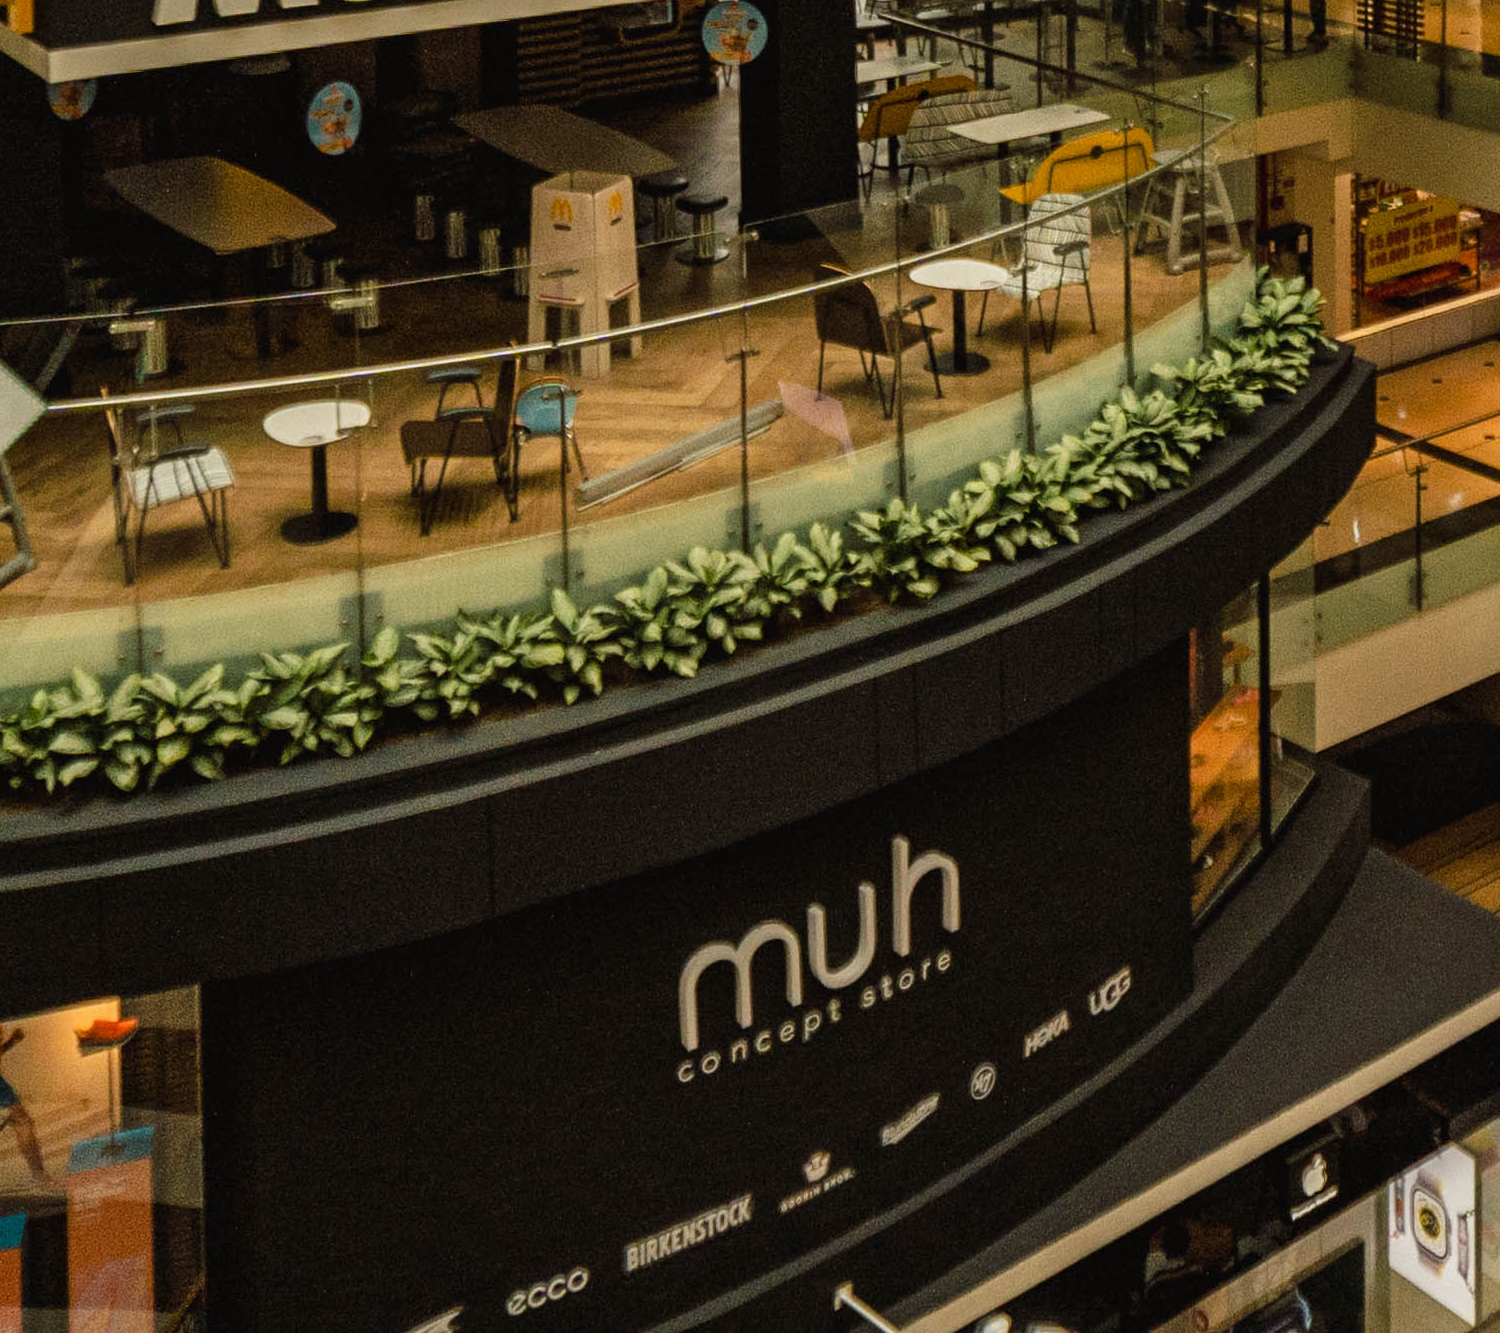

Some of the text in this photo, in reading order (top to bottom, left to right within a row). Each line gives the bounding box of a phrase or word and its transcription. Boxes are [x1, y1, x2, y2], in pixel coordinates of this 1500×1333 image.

[678, 833, 962, 1053] muh
[677, 949, 952, 1084] concept store
[1088, 965, 1131, 1016] UGG
[623, 1192, 753, 1273] BIRKENSTOCK
[506, 1266, 591, 1317] ecco
